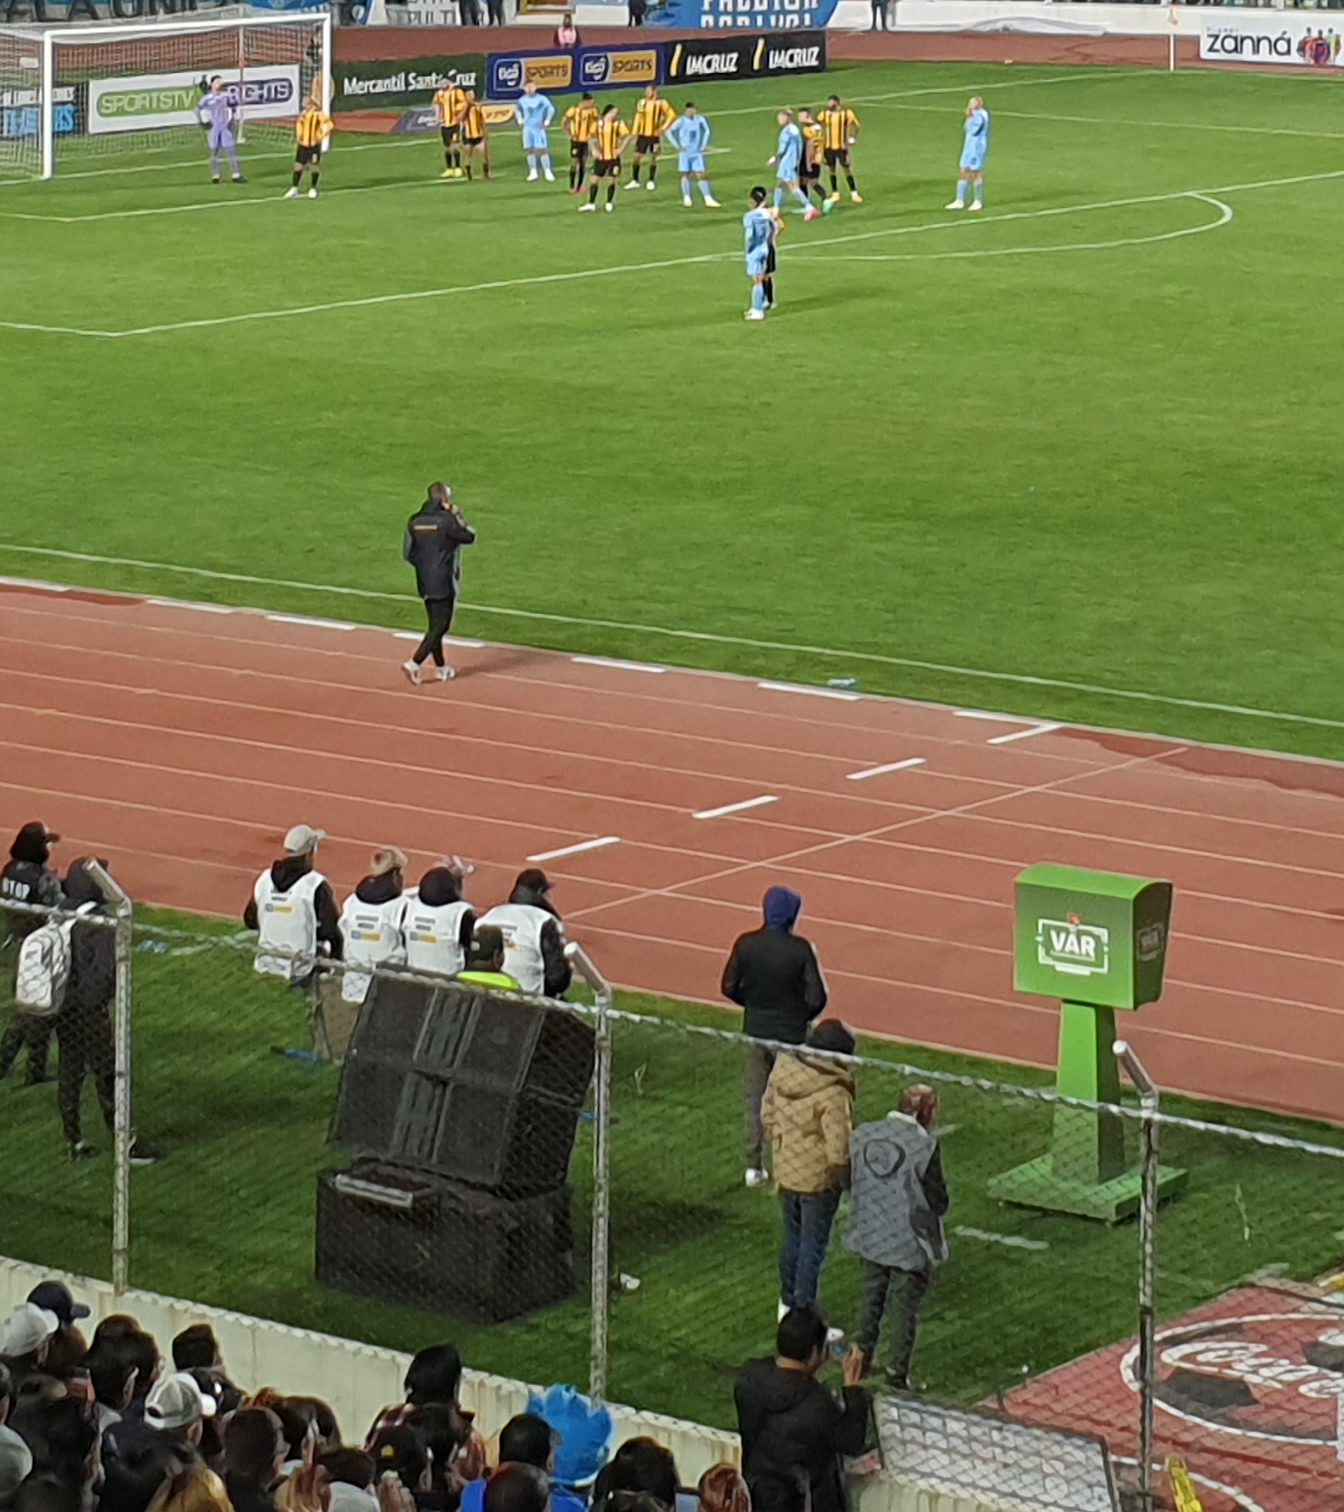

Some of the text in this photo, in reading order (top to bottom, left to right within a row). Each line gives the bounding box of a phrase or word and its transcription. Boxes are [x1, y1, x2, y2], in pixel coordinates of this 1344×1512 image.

[612, 58, 653, 75] SPORTS
[344, 71, 406, 96] Mercantil
[99, 89, 196, 115] SPORTSTV
[1050, 929, 1097, 956] VAR
